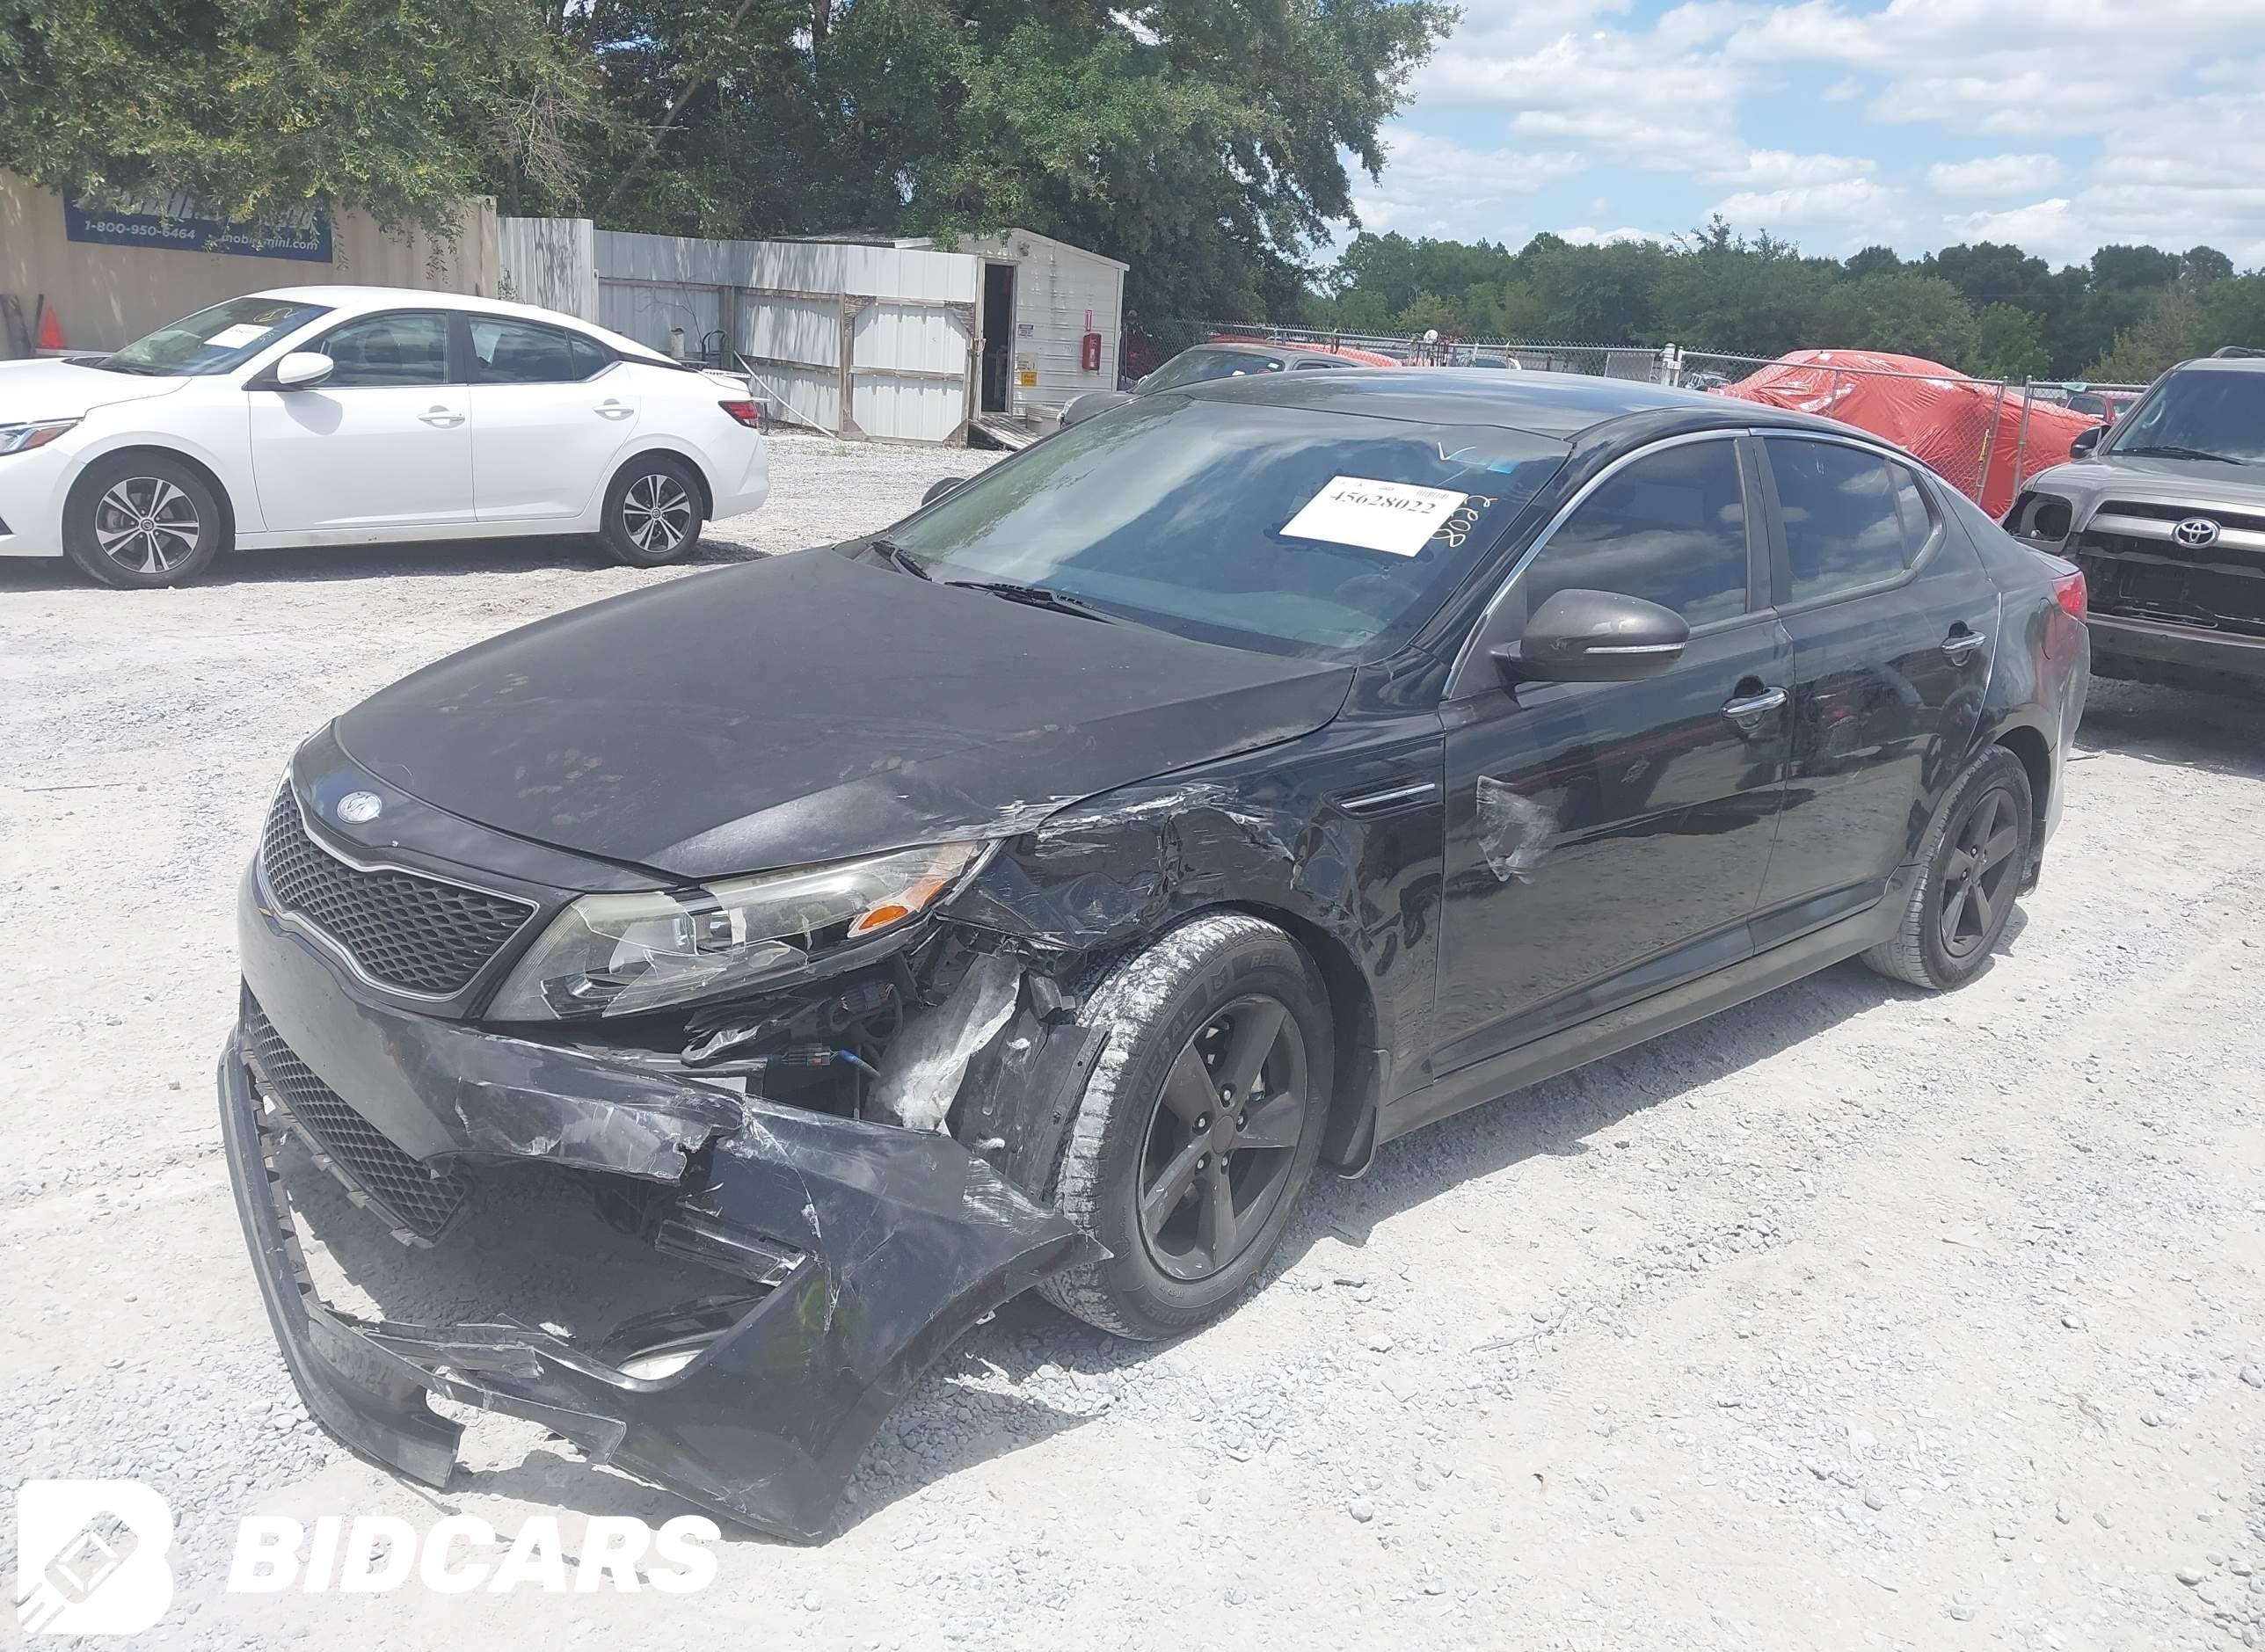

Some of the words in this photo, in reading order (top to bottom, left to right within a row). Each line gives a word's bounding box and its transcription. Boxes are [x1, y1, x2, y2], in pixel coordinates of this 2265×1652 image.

[84, 220, 195, 239] 1-800-950-6464
[222, 233, 317, 251] mobimini.com
[1329, 491, 1437, 514] 45628022
